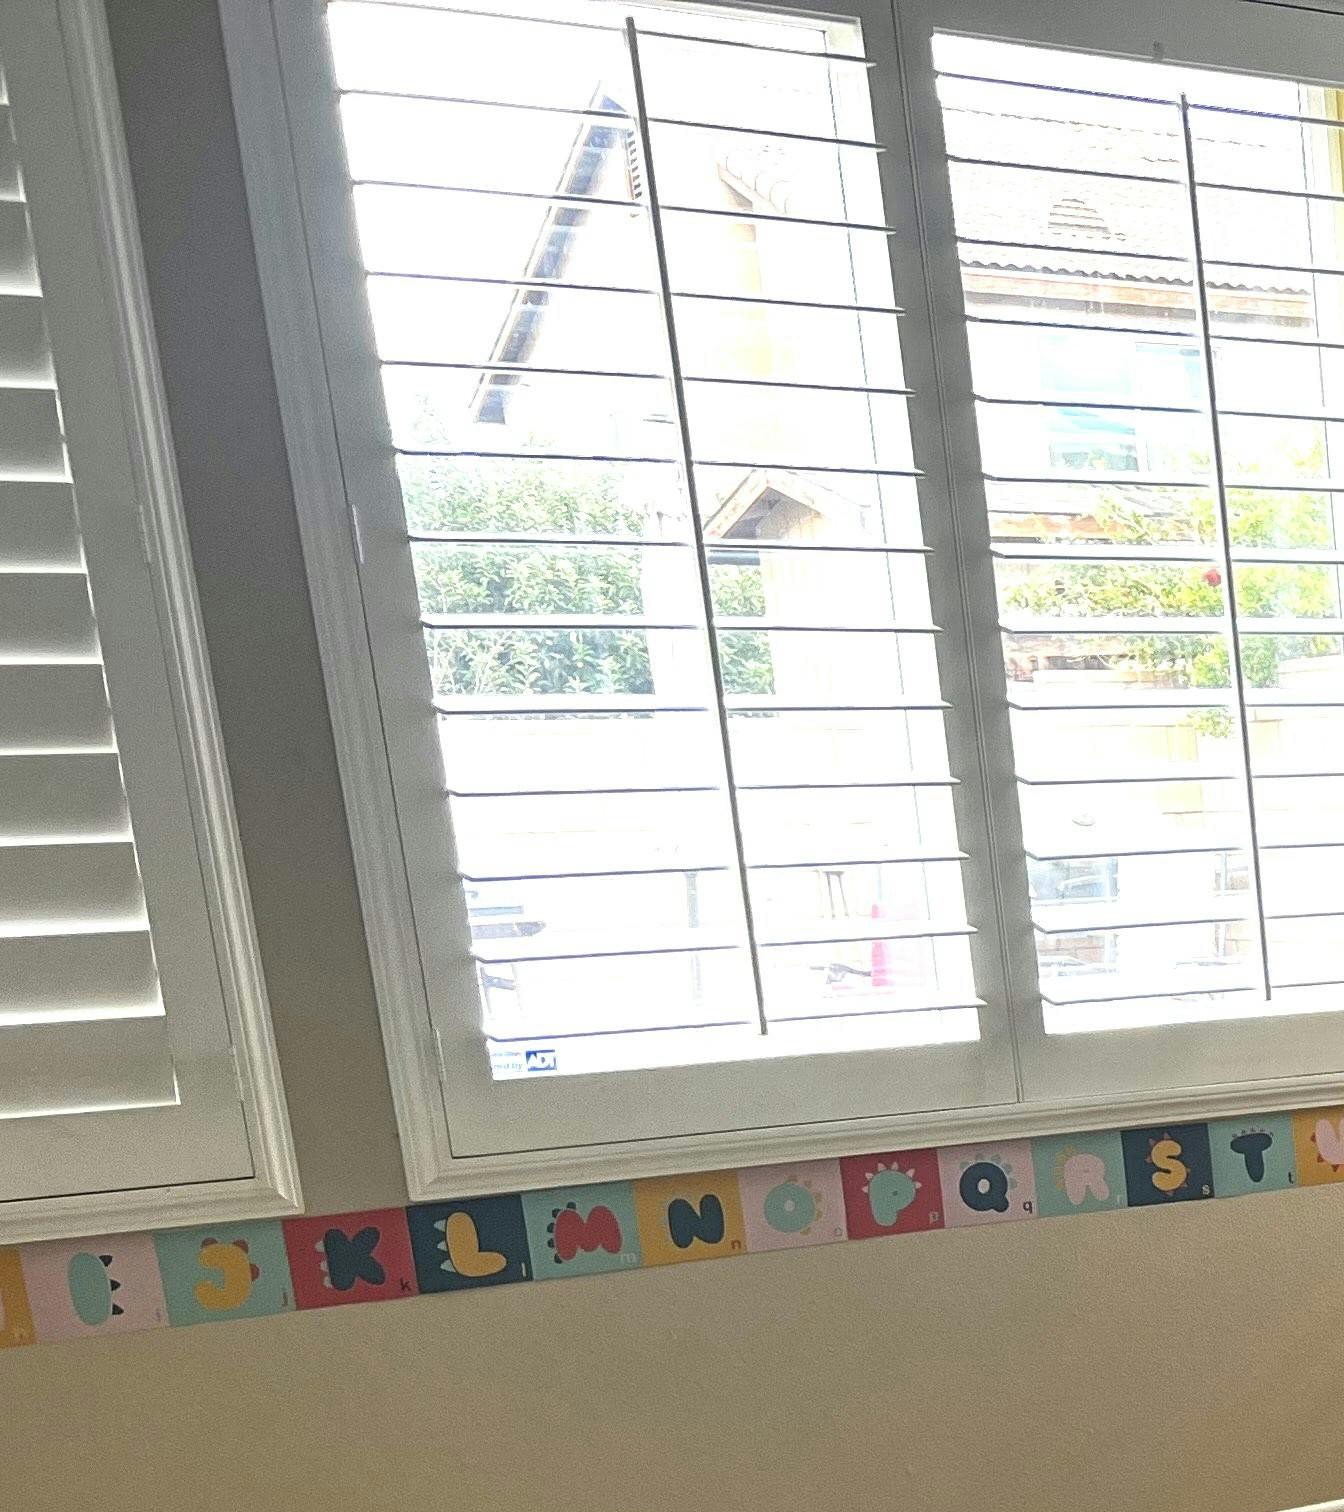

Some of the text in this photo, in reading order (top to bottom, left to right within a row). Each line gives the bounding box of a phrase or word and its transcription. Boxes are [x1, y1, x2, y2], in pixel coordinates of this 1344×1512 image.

[324, 1226, 386, 1291] K
[446, 1211, 508, 1277] L
[555, 1206, 622, 1261] M
[668, 1194, 725, 1248] N
[731, 1240, 742, 1250] n
[869, 1170, 916, 1227] P
[959, 1161, 1009, 1213] Q
[1022, 1201, 1032, 1214] q
[1063, 1153, 1110, 1206] R
[1152, 1140, 1188, 1192] S
[1230, 1133, 1273, 1183] T
